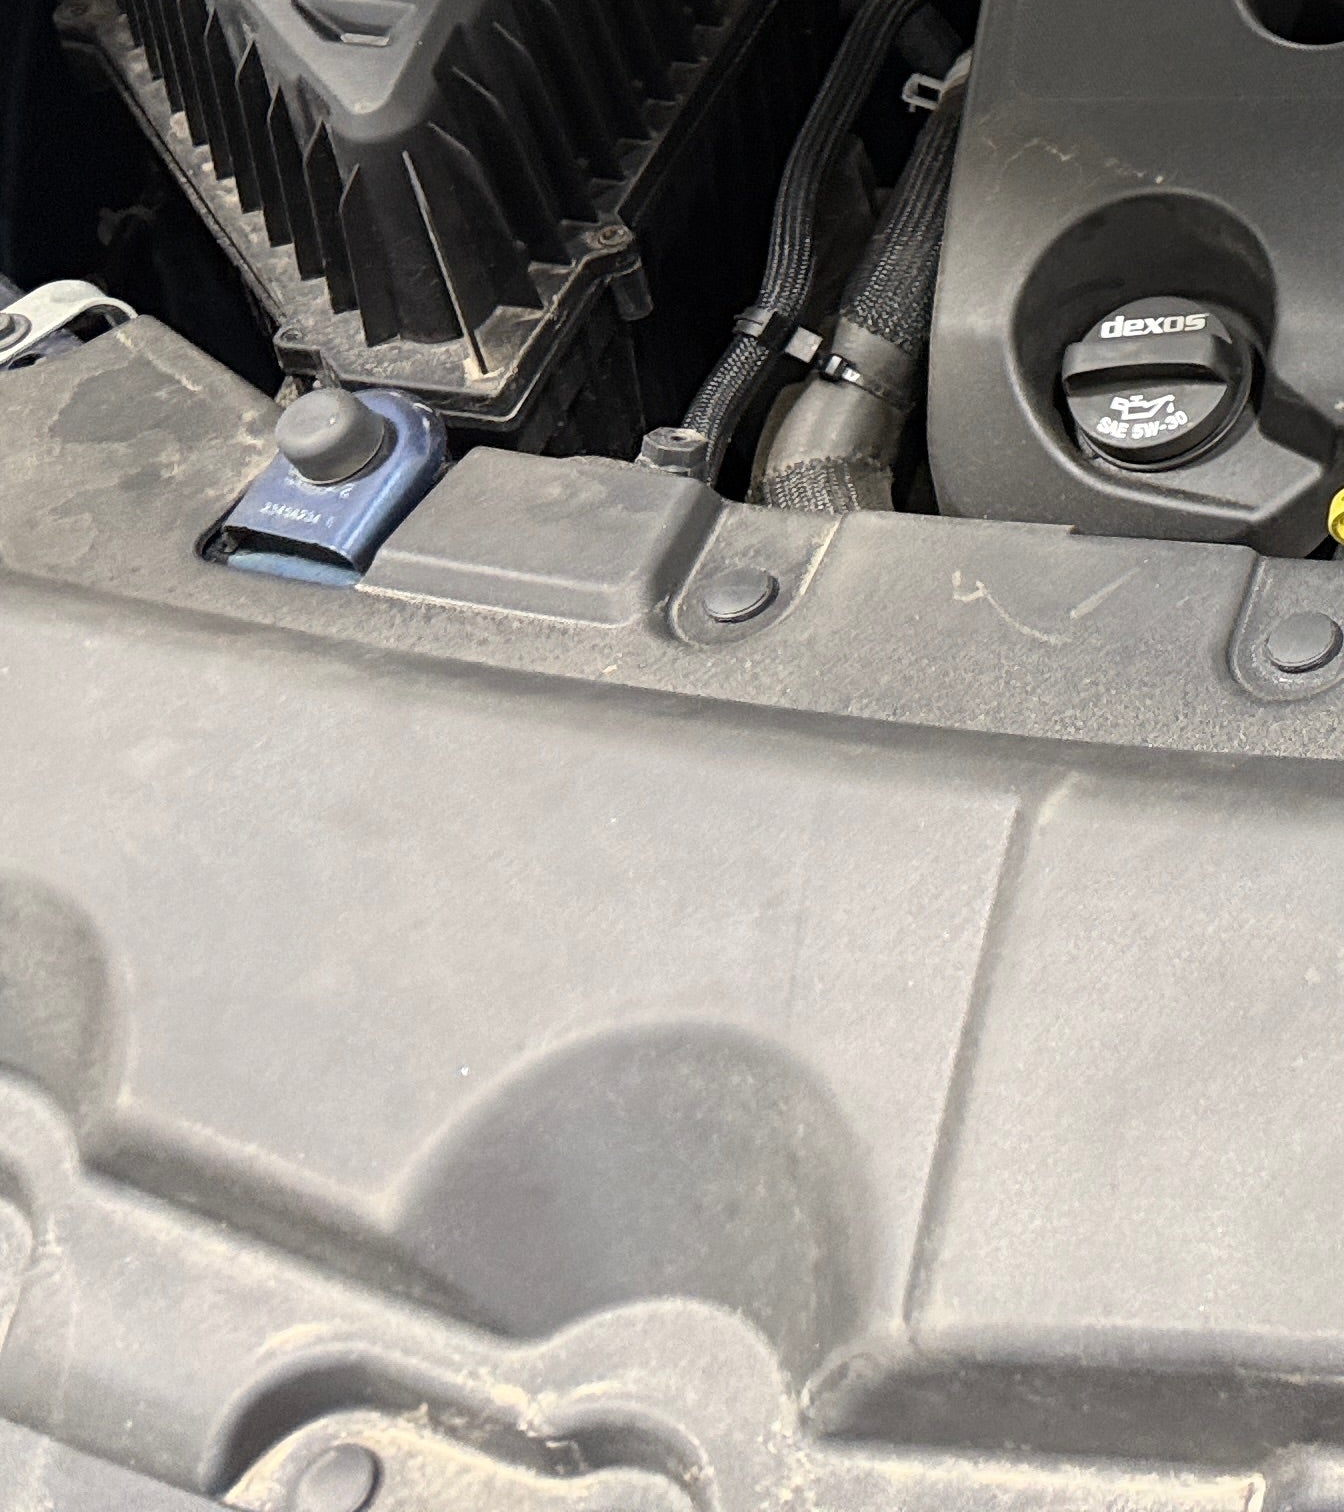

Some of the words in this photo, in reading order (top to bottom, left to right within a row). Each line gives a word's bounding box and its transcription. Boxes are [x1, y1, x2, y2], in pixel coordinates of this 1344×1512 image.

[1100, 313, 1208, 339] dexos
[1096, 417, 1130, 439] SAE
[1131, 410, 1188, 439] 5W-30
